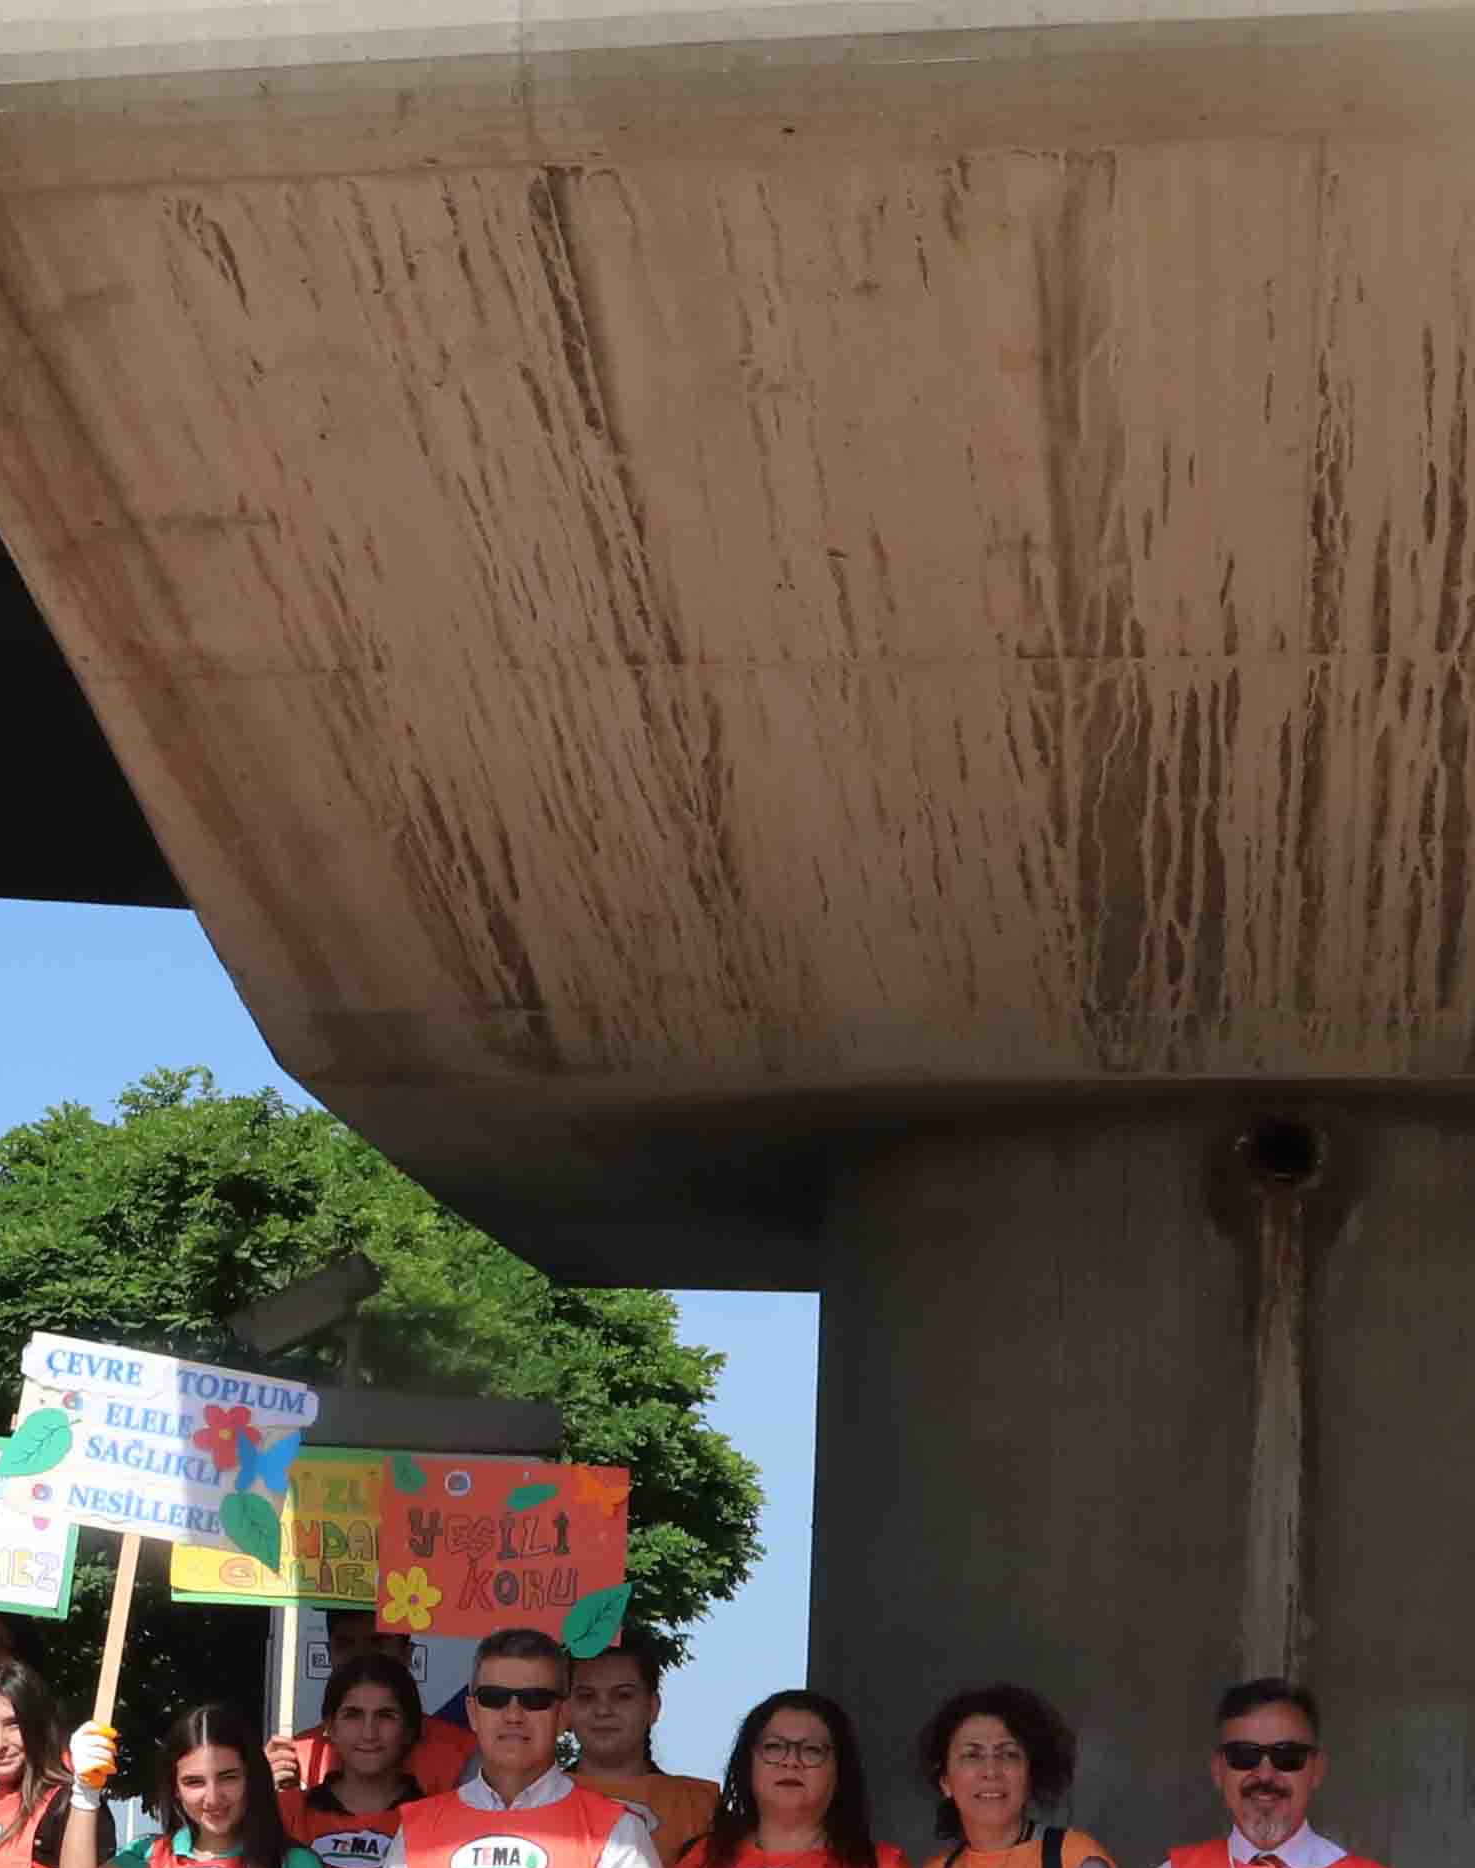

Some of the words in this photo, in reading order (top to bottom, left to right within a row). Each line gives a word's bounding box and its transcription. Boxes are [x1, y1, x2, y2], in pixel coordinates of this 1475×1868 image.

[46, 1349, 145, 1386] ÇEVRE
[177, 1368, 307, 1416] TOPLUM
[106, 1402, 195, 1439] ELELE
[85, 1435, 225, 1487] SAĞLIKLI
[68, 1483, 220, 1534] NESİLLERE
[457, 1557, 579, 1612] KORU
[331, 1836, 380, 1855] TEMA
[471, 1846, 521, 1866] TEMA
